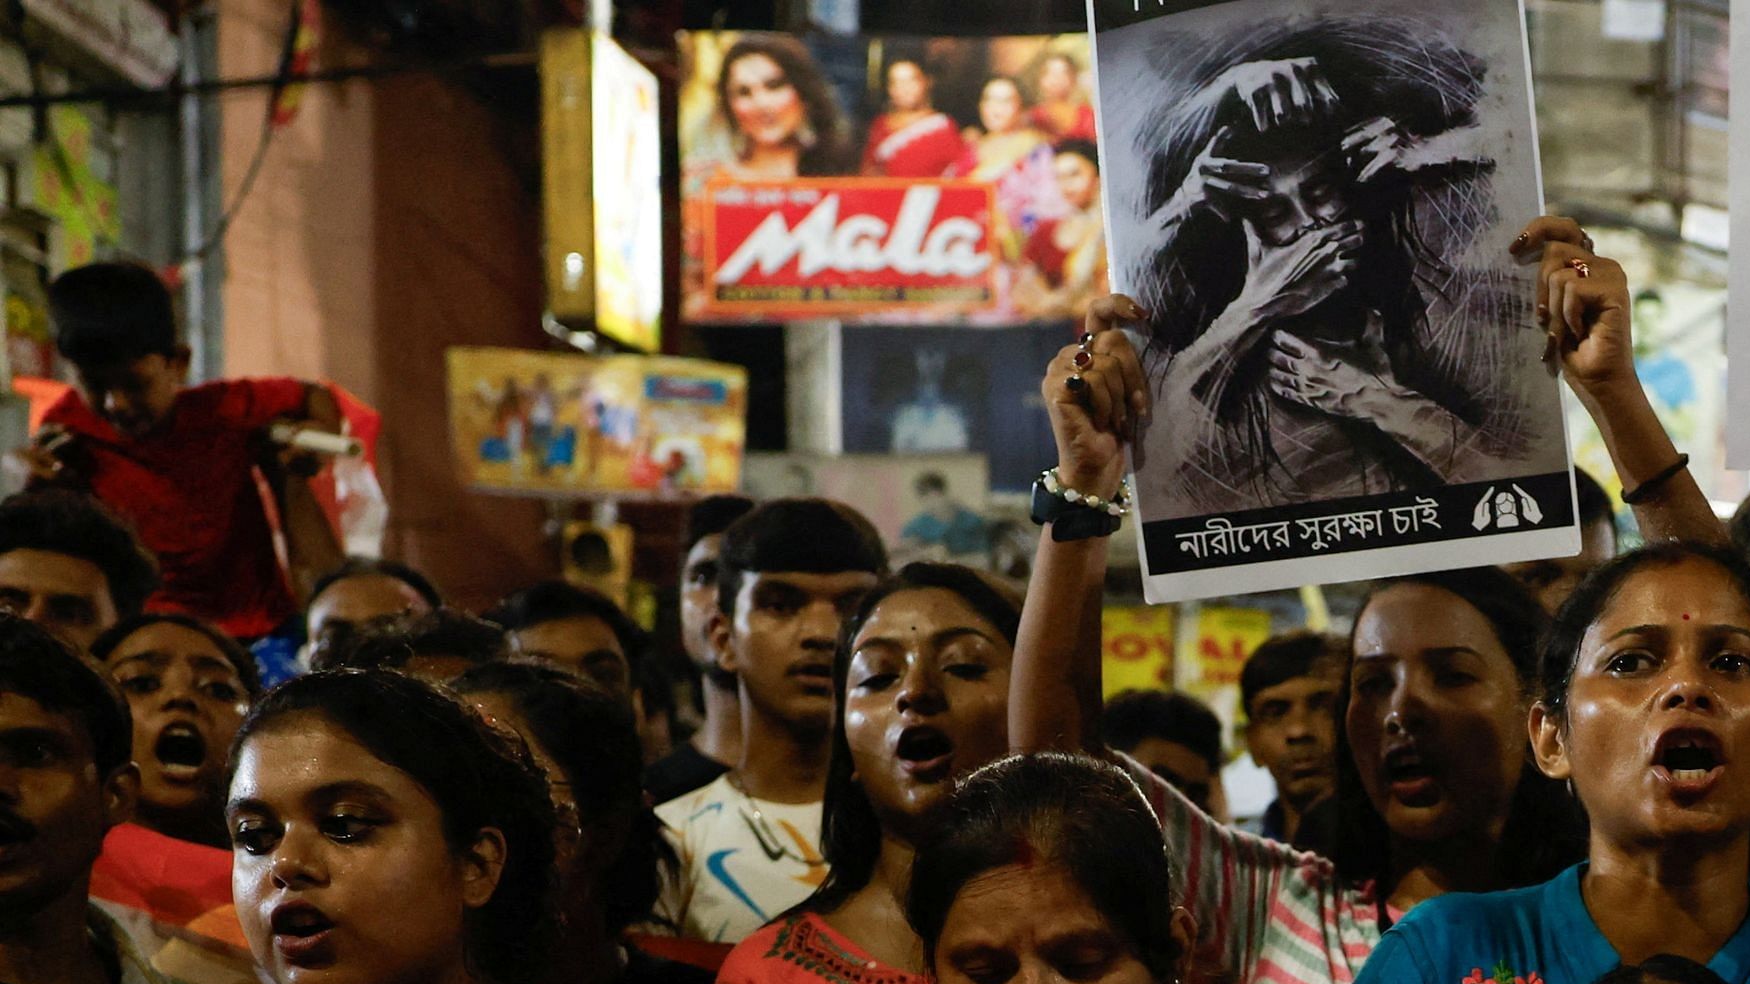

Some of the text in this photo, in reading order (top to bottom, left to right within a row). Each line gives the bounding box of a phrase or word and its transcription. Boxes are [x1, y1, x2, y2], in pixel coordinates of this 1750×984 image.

[715, 185, 993, 284] Mala
[1176, 497, 1442, 559] নারীদের সুরক্ষা চাই
